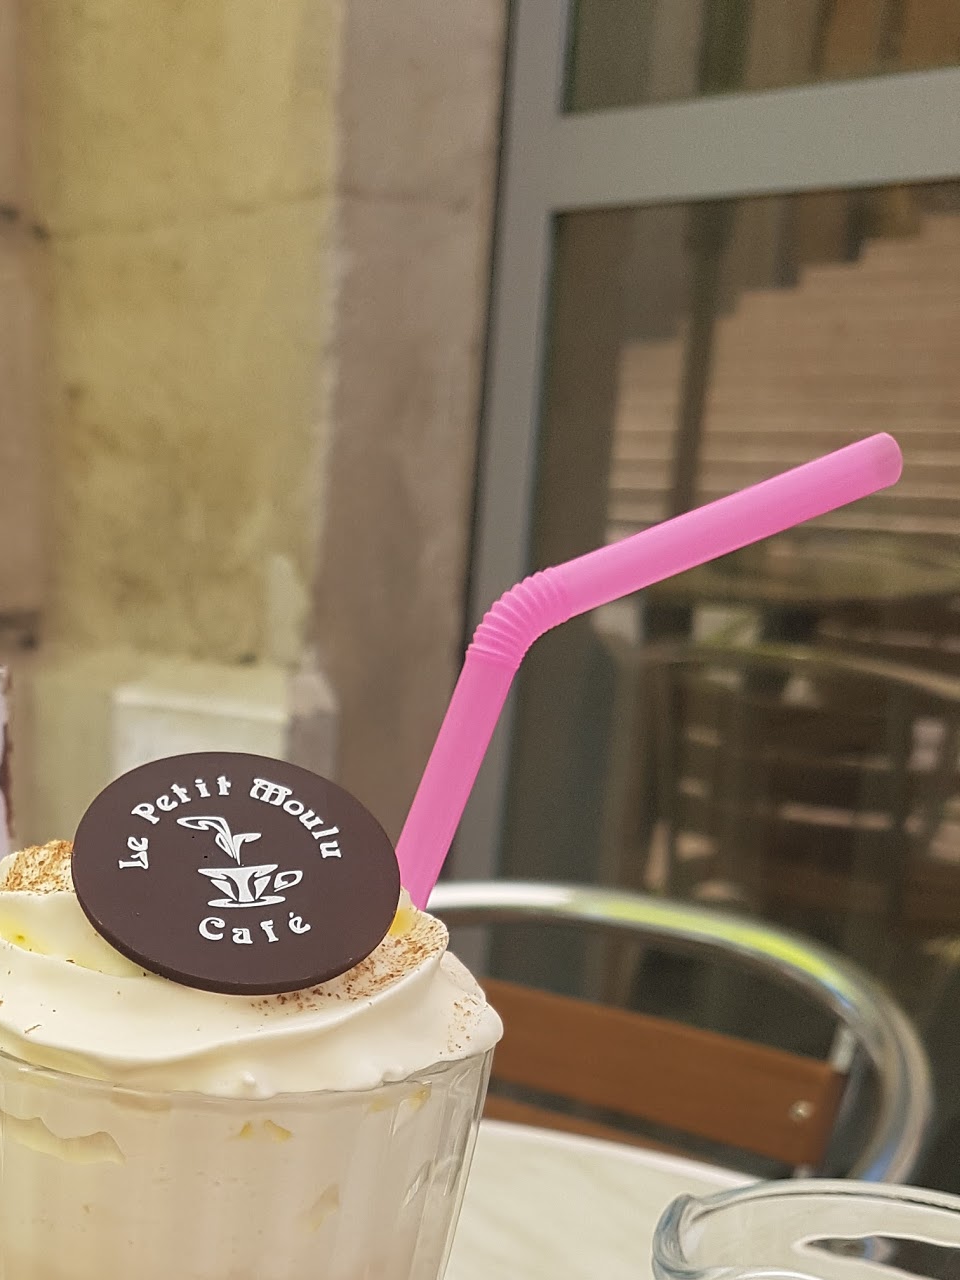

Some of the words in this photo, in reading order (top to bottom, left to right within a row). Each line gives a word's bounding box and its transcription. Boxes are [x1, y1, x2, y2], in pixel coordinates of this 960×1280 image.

[131, 775, 232, 825] Petit
[248, 778, 342, 859] Moulu
[118, 836, 149, 870] Le
[198, 912, 312, 945] Café
